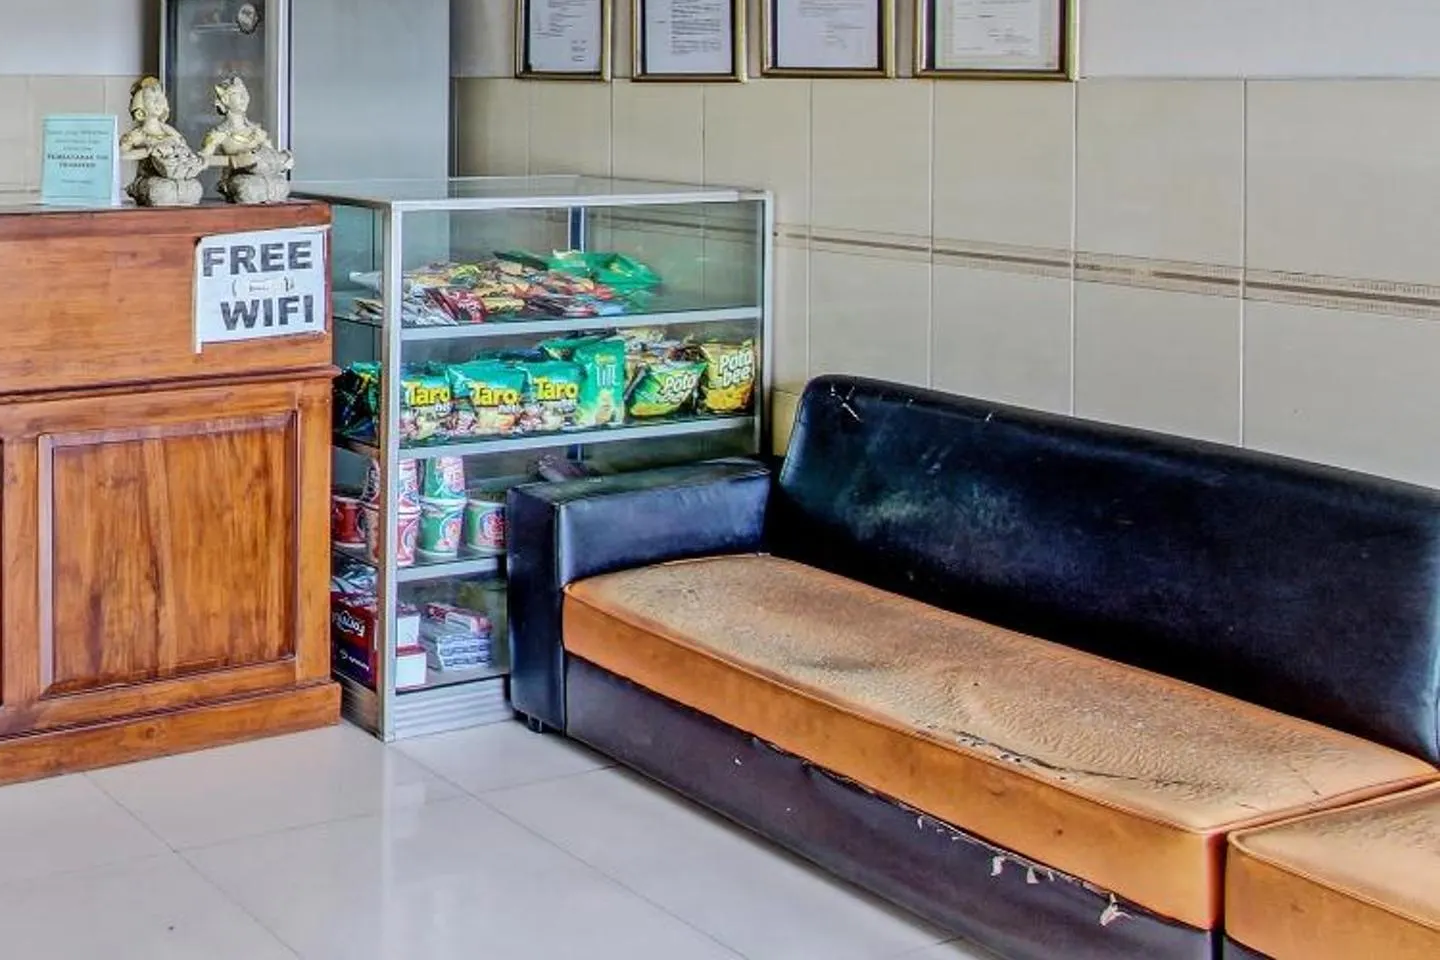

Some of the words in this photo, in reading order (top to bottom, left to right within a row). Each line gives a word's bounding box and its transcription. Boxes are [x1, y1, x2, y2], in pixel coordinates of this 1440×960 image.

[202, 240, 312, 277] FREE
[220, 294, 314, 331] WIFI
[401, 380, 451, 407] Taro
[468, 380, 519, 407] Taro
[533, 377, 579, 400] Taro
